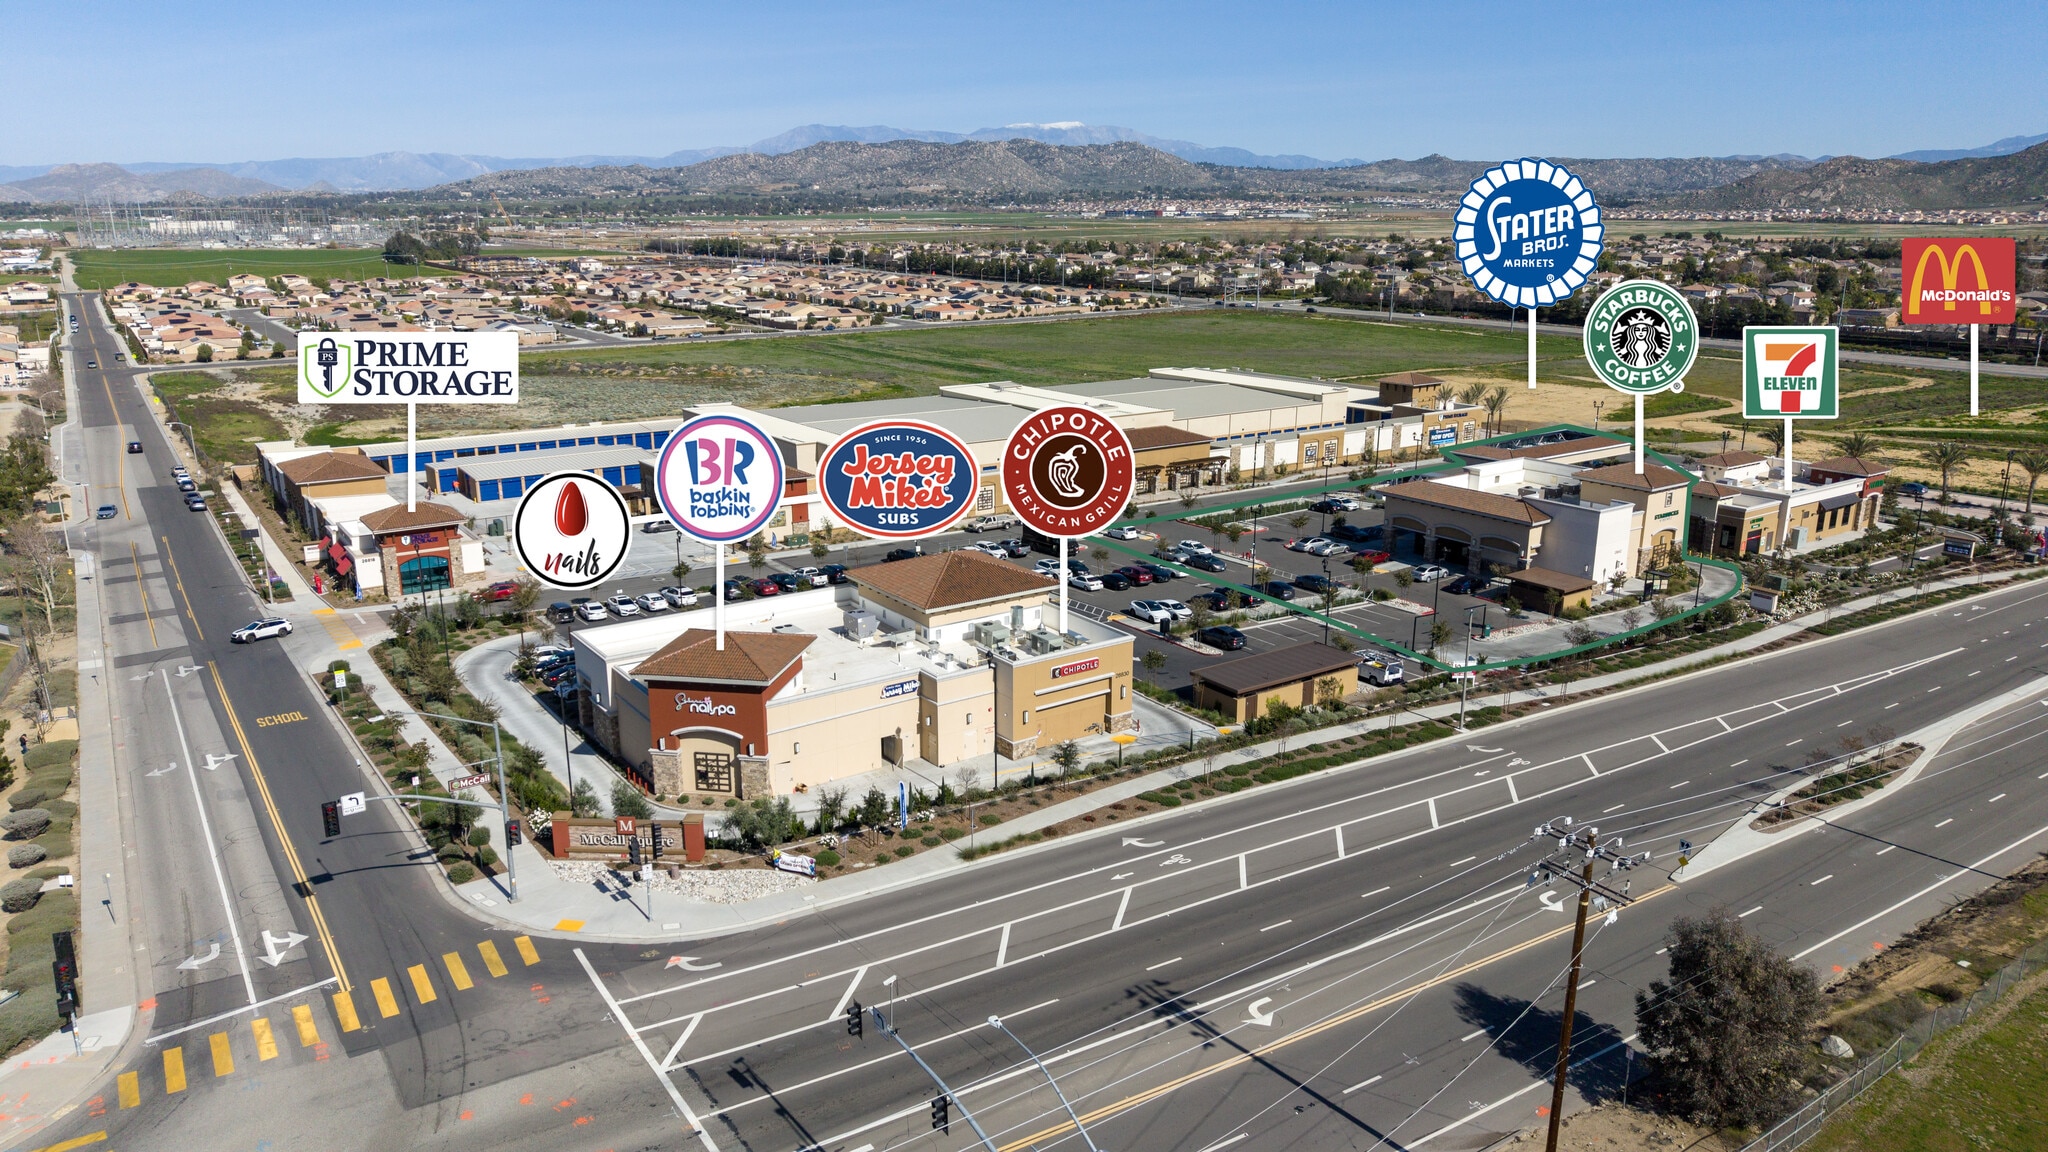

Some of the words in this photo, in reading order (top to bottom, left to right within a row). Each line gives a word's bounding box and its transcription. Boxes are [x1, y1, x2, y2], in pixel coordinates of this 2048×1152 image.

[1063, 660, 1098, 674] CHIPOTLE
[256, 711, 308, 727] SCHOOL
[460, 774, 490, 788] McCall
[620, 821, 633, 831] M
[581, 834, 625, 845] McCall
